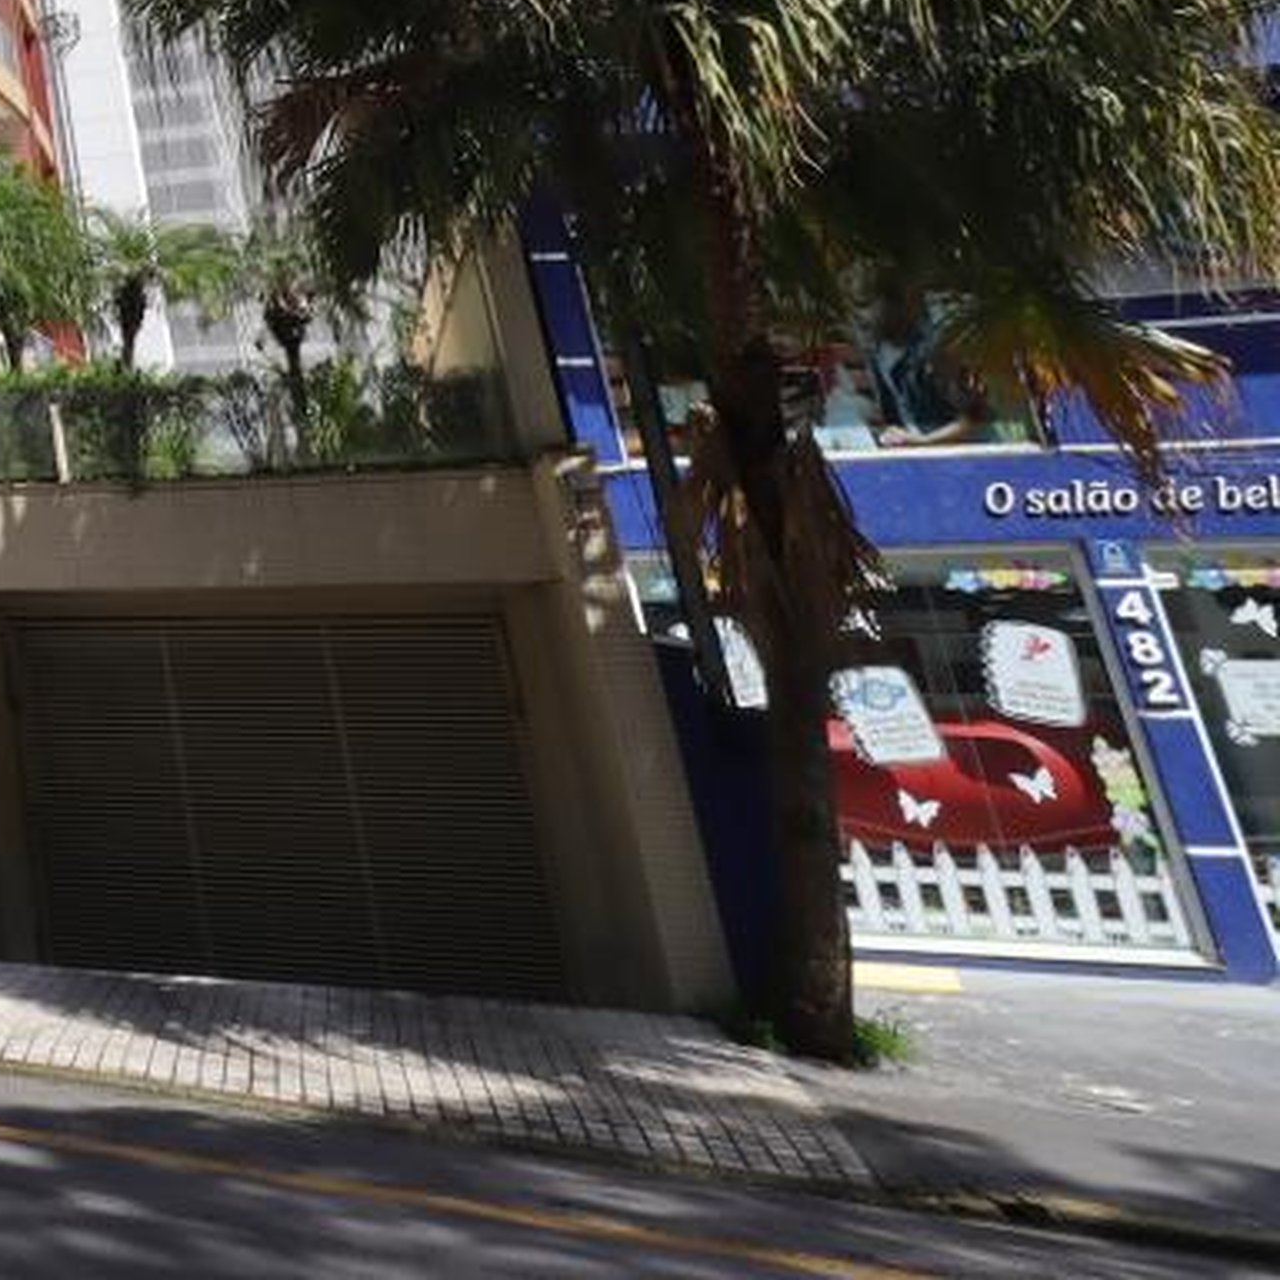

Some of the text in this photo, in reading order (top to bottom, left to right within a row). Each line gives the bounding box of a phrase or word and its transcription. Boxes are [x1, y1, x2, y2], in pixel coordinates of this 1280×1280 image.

[985, 475, 1280, 514] O salão de bel
[1116, 591, 1180, 704] 482
